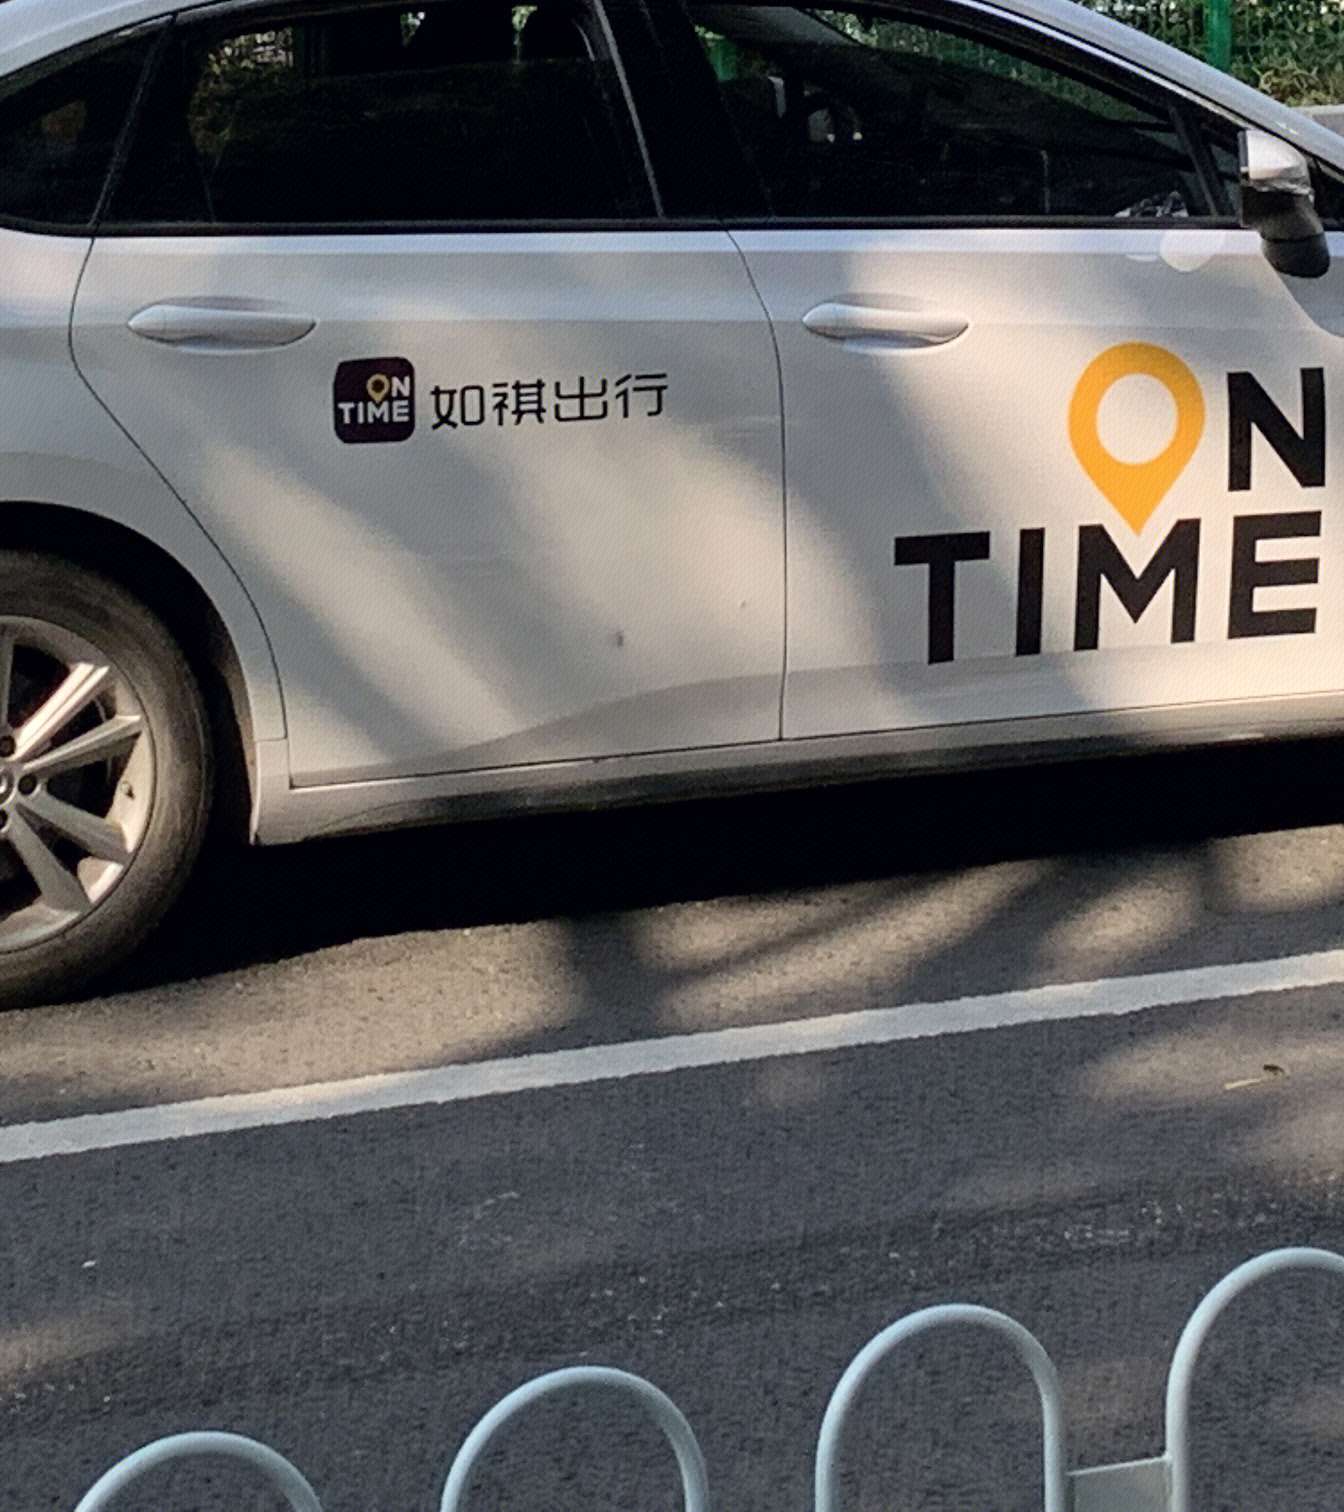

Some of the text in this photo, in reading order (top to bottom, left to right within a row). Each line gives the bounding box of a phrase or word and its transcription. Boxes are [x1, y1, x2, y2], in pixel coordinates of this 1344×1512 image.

[337, 399, 410, 425] TIME
[366, 373, 410, 404] ON
[430, 373, 668, 430] 如祺出行
[1068, 340, 1327, 536] ON
[894, 510, 1322, 665] TIME
